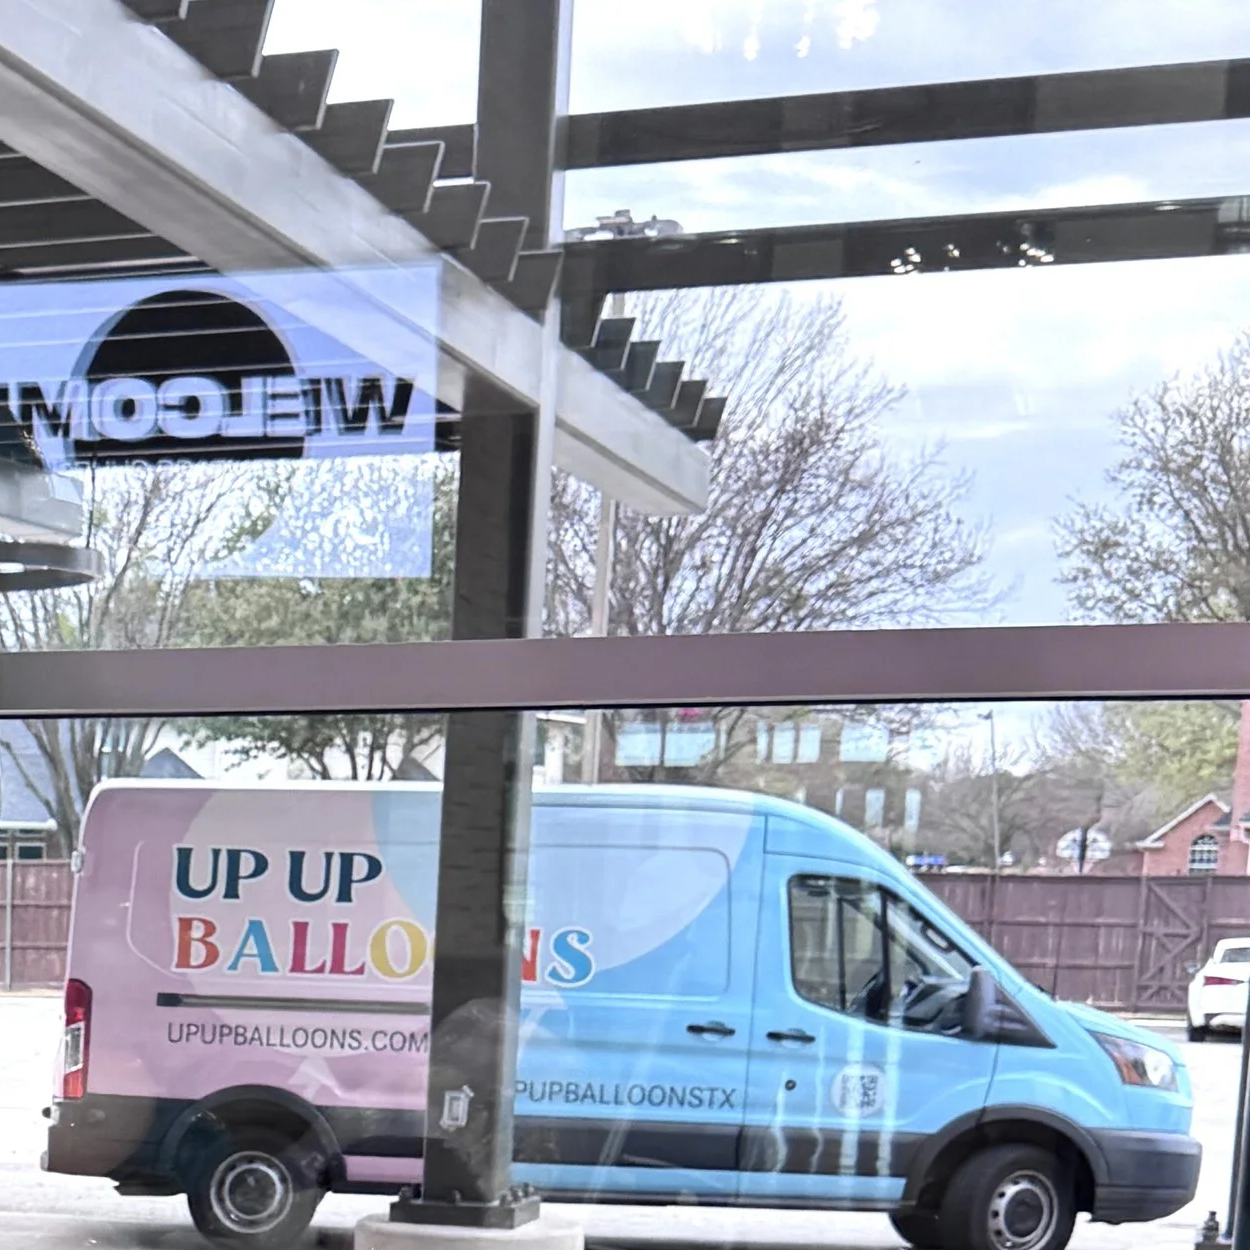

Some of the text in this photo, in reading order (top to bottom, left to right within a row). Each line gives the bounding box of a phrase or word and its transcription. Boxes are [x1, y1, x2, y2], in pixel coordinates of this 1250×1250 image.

[175, 846, 383, 904] UP UP
[174, 916, 594, 986] BALLOS
[167, 1021, 429, 1053] UPUPBALLOONS.COM
[513, 1079, 738, 1110] PUPBALLOONSTX
